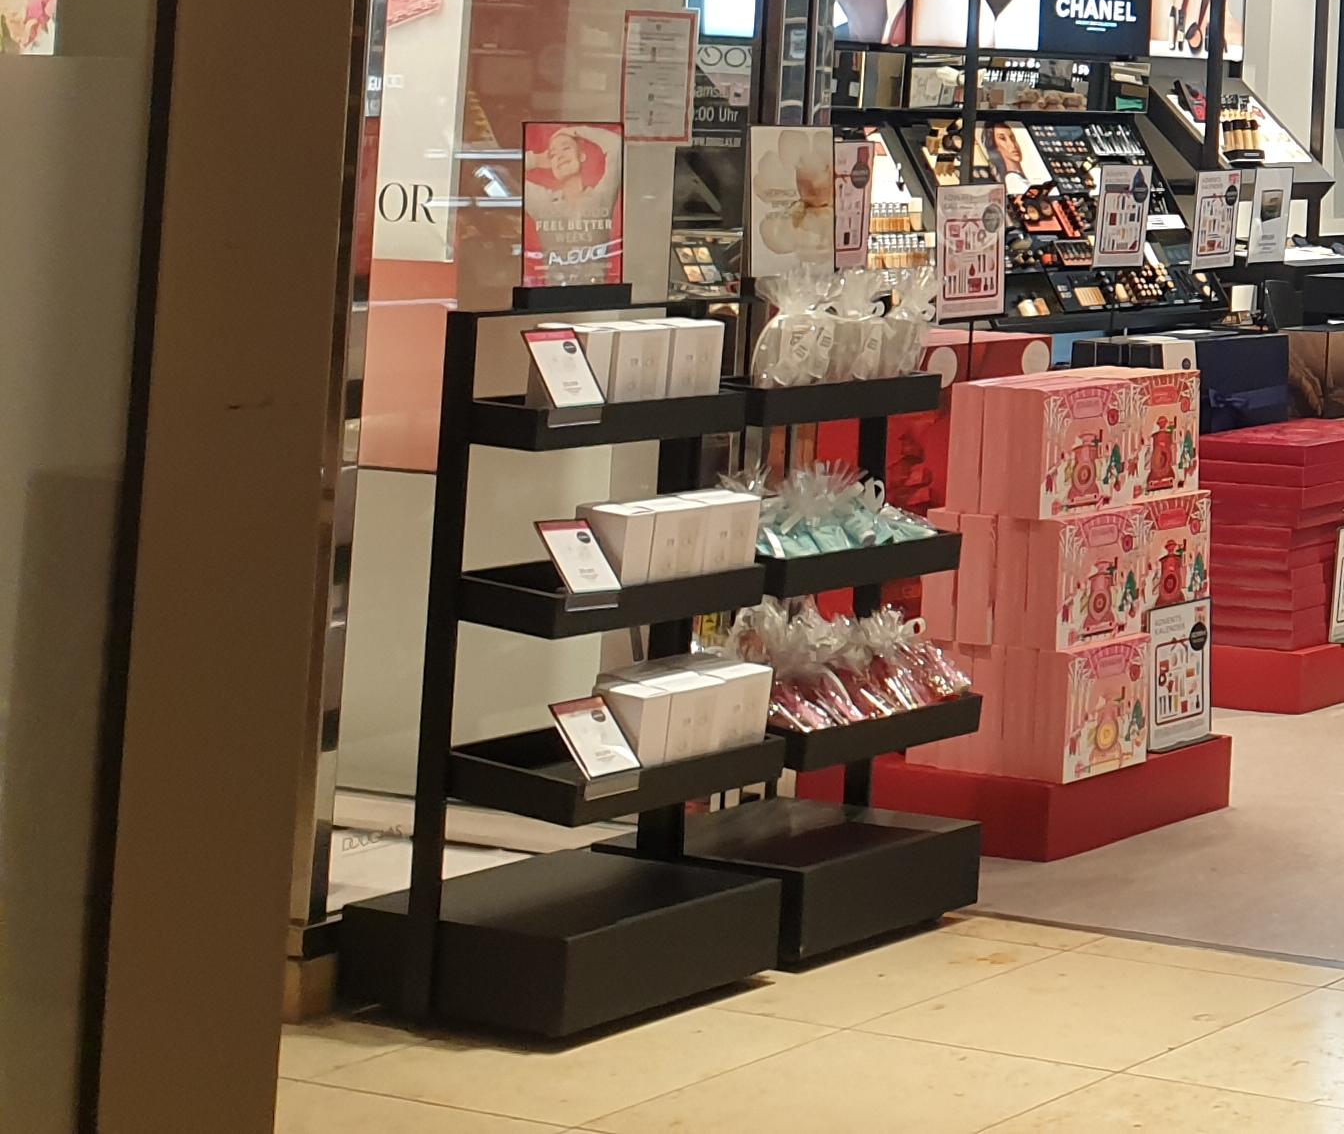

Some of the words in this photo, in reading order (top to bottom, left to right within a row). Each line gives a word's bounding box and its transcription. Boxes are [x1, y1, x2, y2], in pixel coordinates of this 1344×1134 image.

[718, 106, 739, 123] Uhr
[378, 182, 436, 224] OR
[535, 219, 565, 232] FEEL
